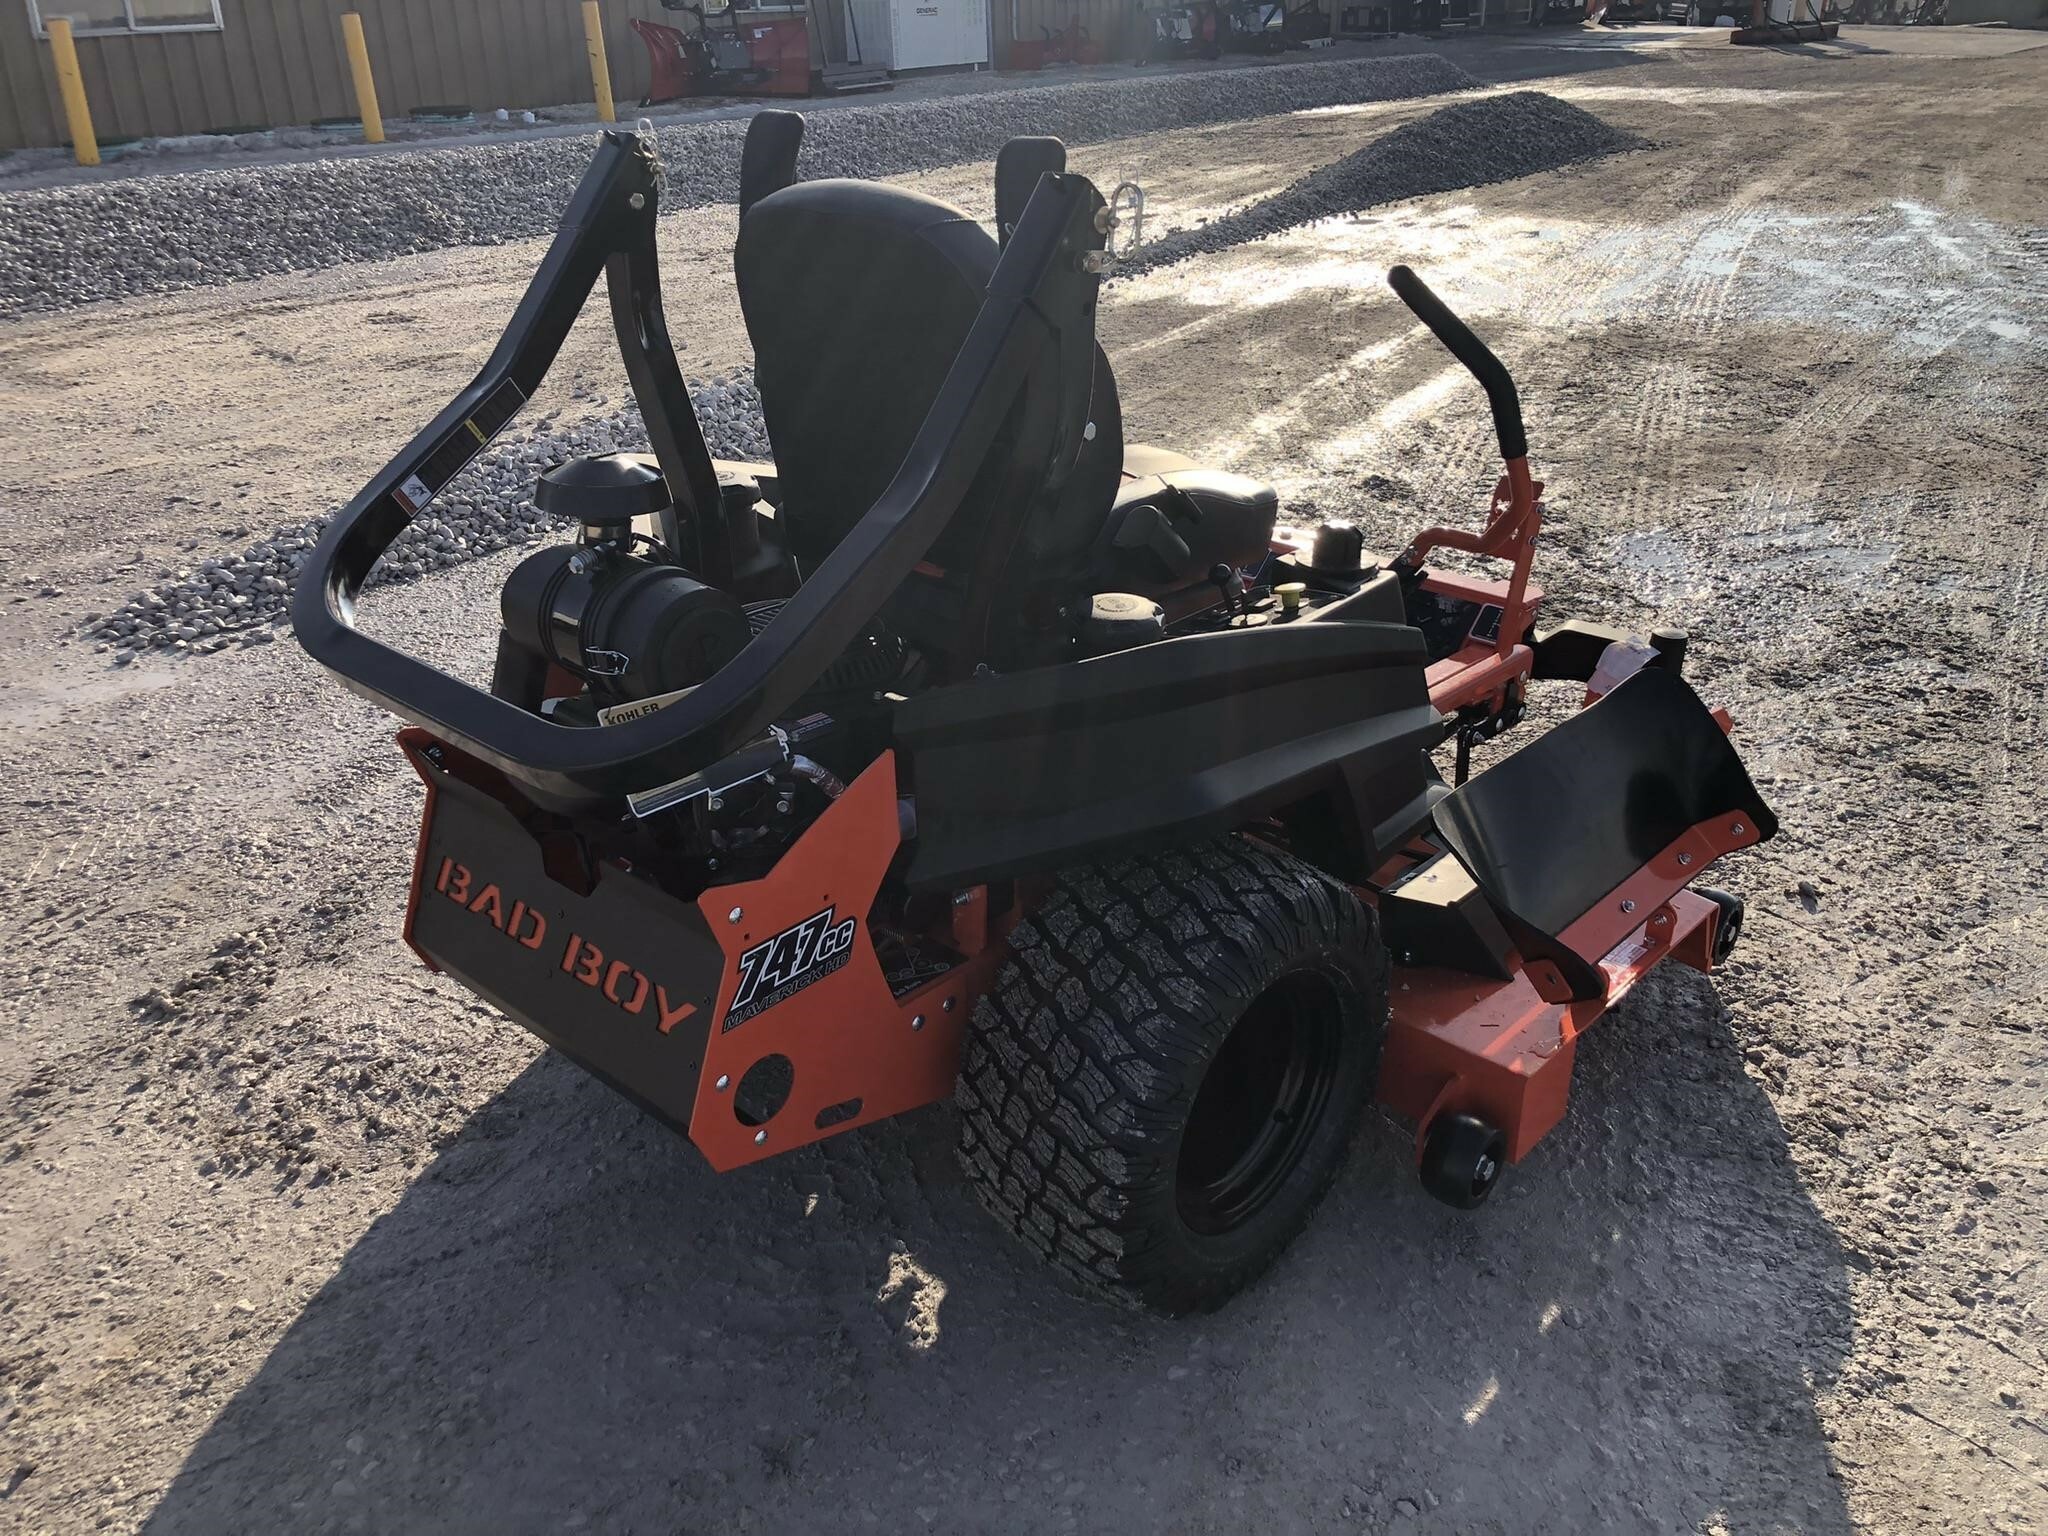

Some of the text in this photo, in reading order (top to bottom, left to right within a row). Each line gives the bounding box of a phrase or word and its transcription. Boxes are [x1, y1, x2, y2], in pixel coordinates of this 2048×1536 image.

[605, 702, 660, 725] KOHLER
[435, 856, 698, 1036] BAD BOY
[723, 951, 850, 1032] MAVERICK HD
